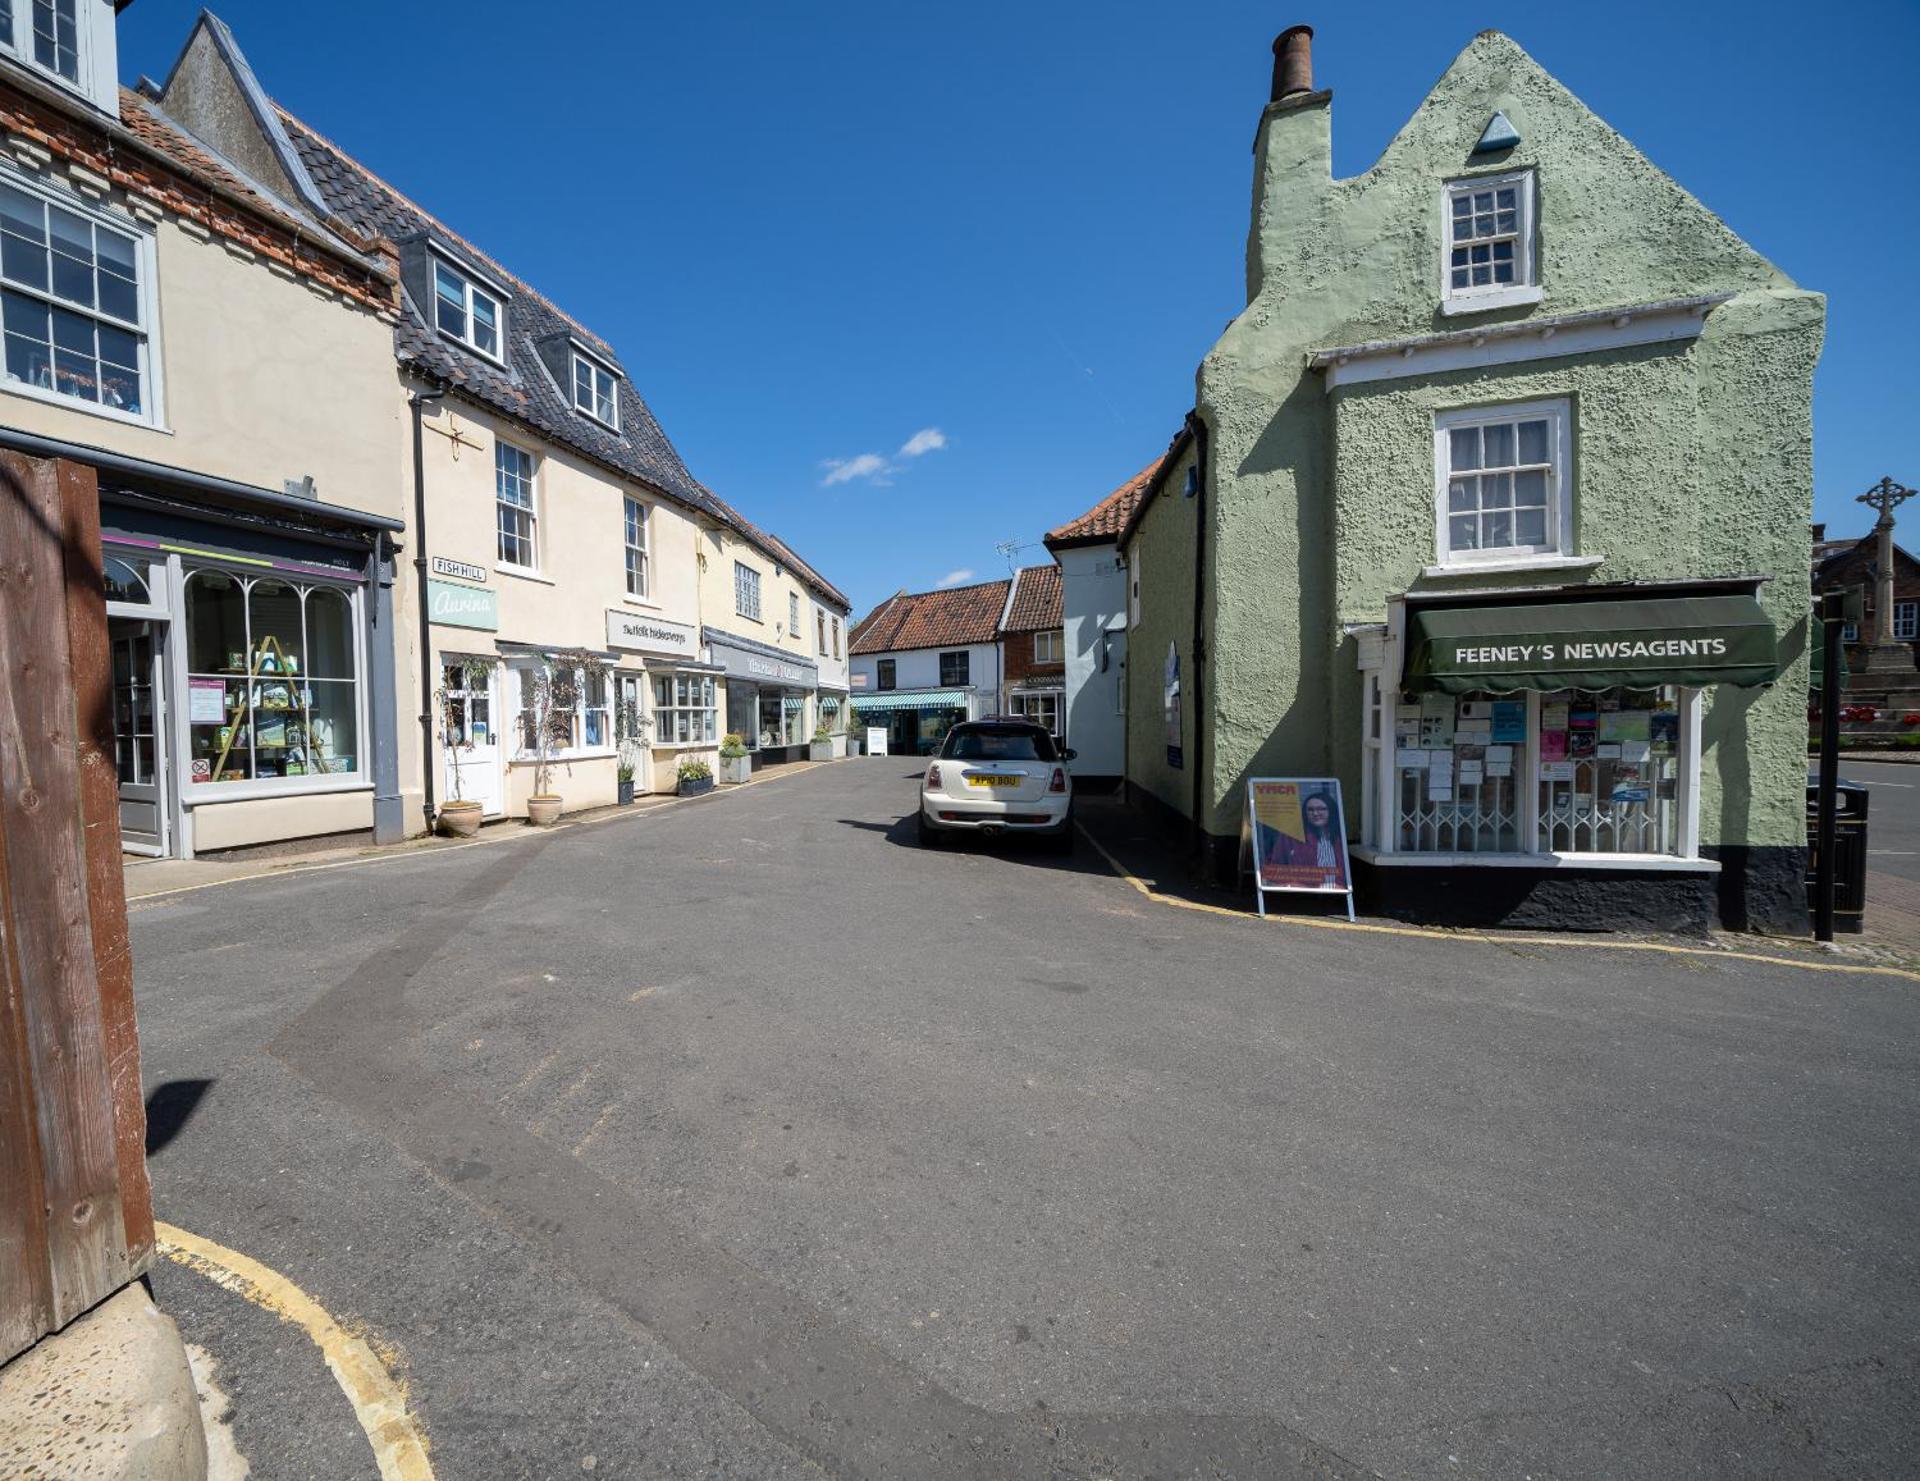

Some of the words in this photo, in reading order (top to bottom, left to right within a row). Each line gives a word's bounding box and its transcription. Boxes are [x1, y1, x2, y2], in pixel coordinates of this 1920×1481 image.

[437, 560, 459, 574] FISH
[461, 565, 483, 580] HILL
[1455, 644, 1555, 664] FEENEY'S
[1563, 638, 1727, 660] NEWSAGENTS
[1255, 784, 1297, 795] YMCA
